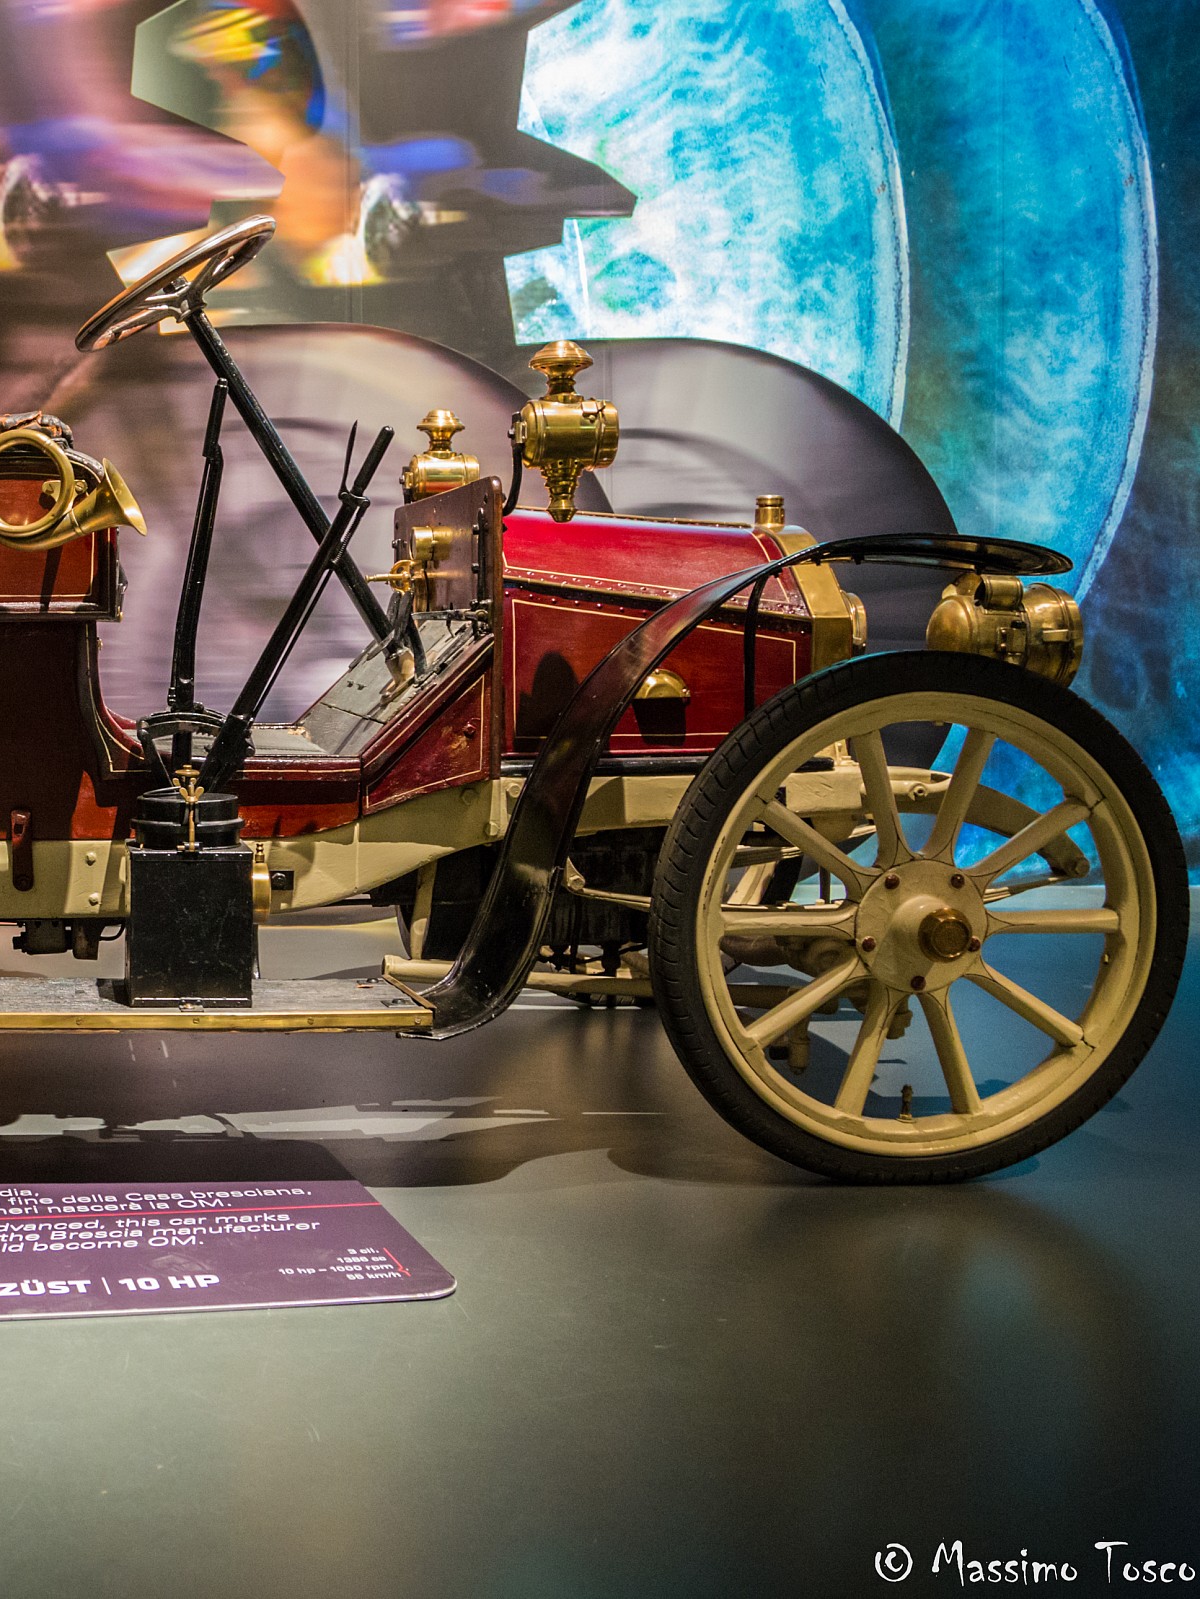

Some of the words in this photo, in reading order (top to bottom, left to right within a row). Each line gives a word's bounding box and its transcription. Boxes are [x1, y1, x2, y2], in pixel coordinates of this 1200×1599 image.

[9, 1197, 53, 1206] fine
[62, 1194, 117, 1204] della
[125, 1193, 183, 1201] Casa
[190, 1187, 312, 1199] bresciana,
[48, 1201, 142, 1213] nascerà
[150, 1200, 170, 1209] la
[177, 1199, 232, 1208] OM.
[116, 1218, 159, 1228] this
[169, 1216, 206, 1226] car
[215, 1212, 290, 1223] marks
[0, 1232, 40, 1242] the
[50, 1228, 143, 1239] Brescia
[153, 1221, 320, 1235] manufacturer
[33, 1239, 138, 1252] become
[148, 1235, 204, 1247] OM.
[118, 1277, 160, 1291] 10
[169, 1275, 220, 1289] HP
